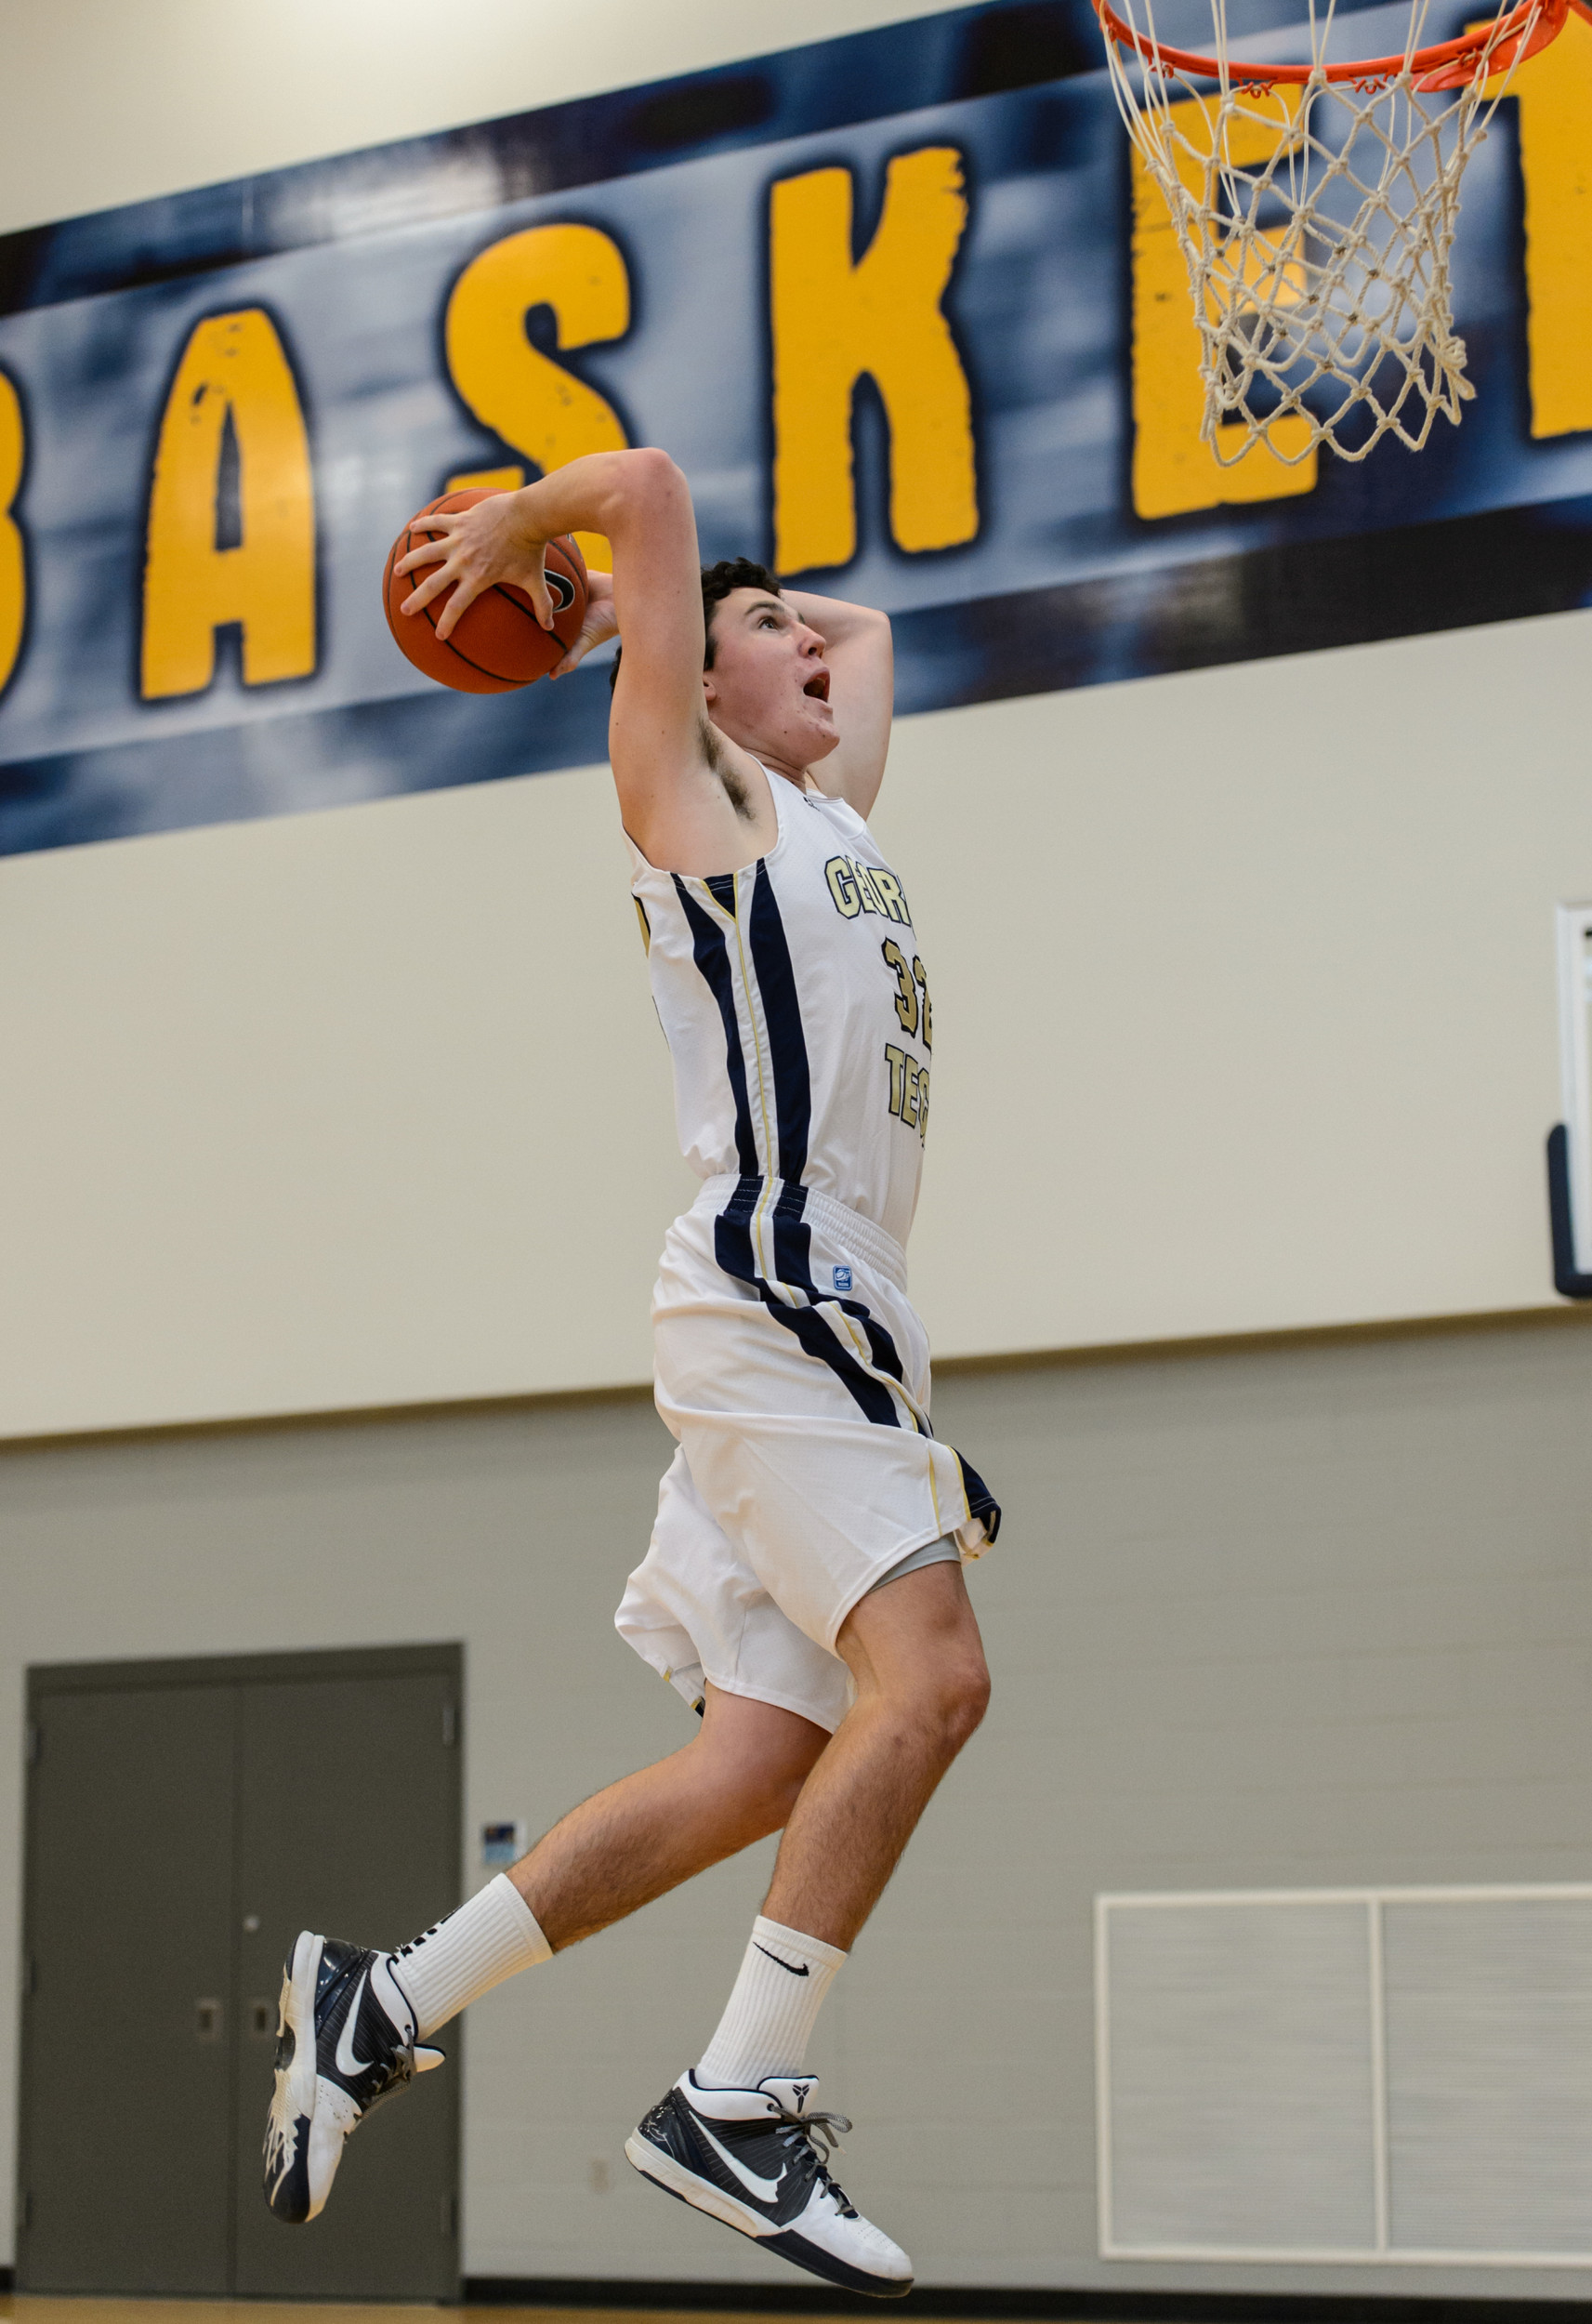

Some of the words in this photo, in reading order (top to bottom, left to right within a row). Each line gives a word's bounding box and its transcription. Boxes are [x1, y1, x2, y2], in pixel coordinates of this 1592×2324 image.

[0, 0, 1592, 702] ASKET
[823, 854, 916, 941] GEOR
[885, 1042, 929, 1149] TEC
